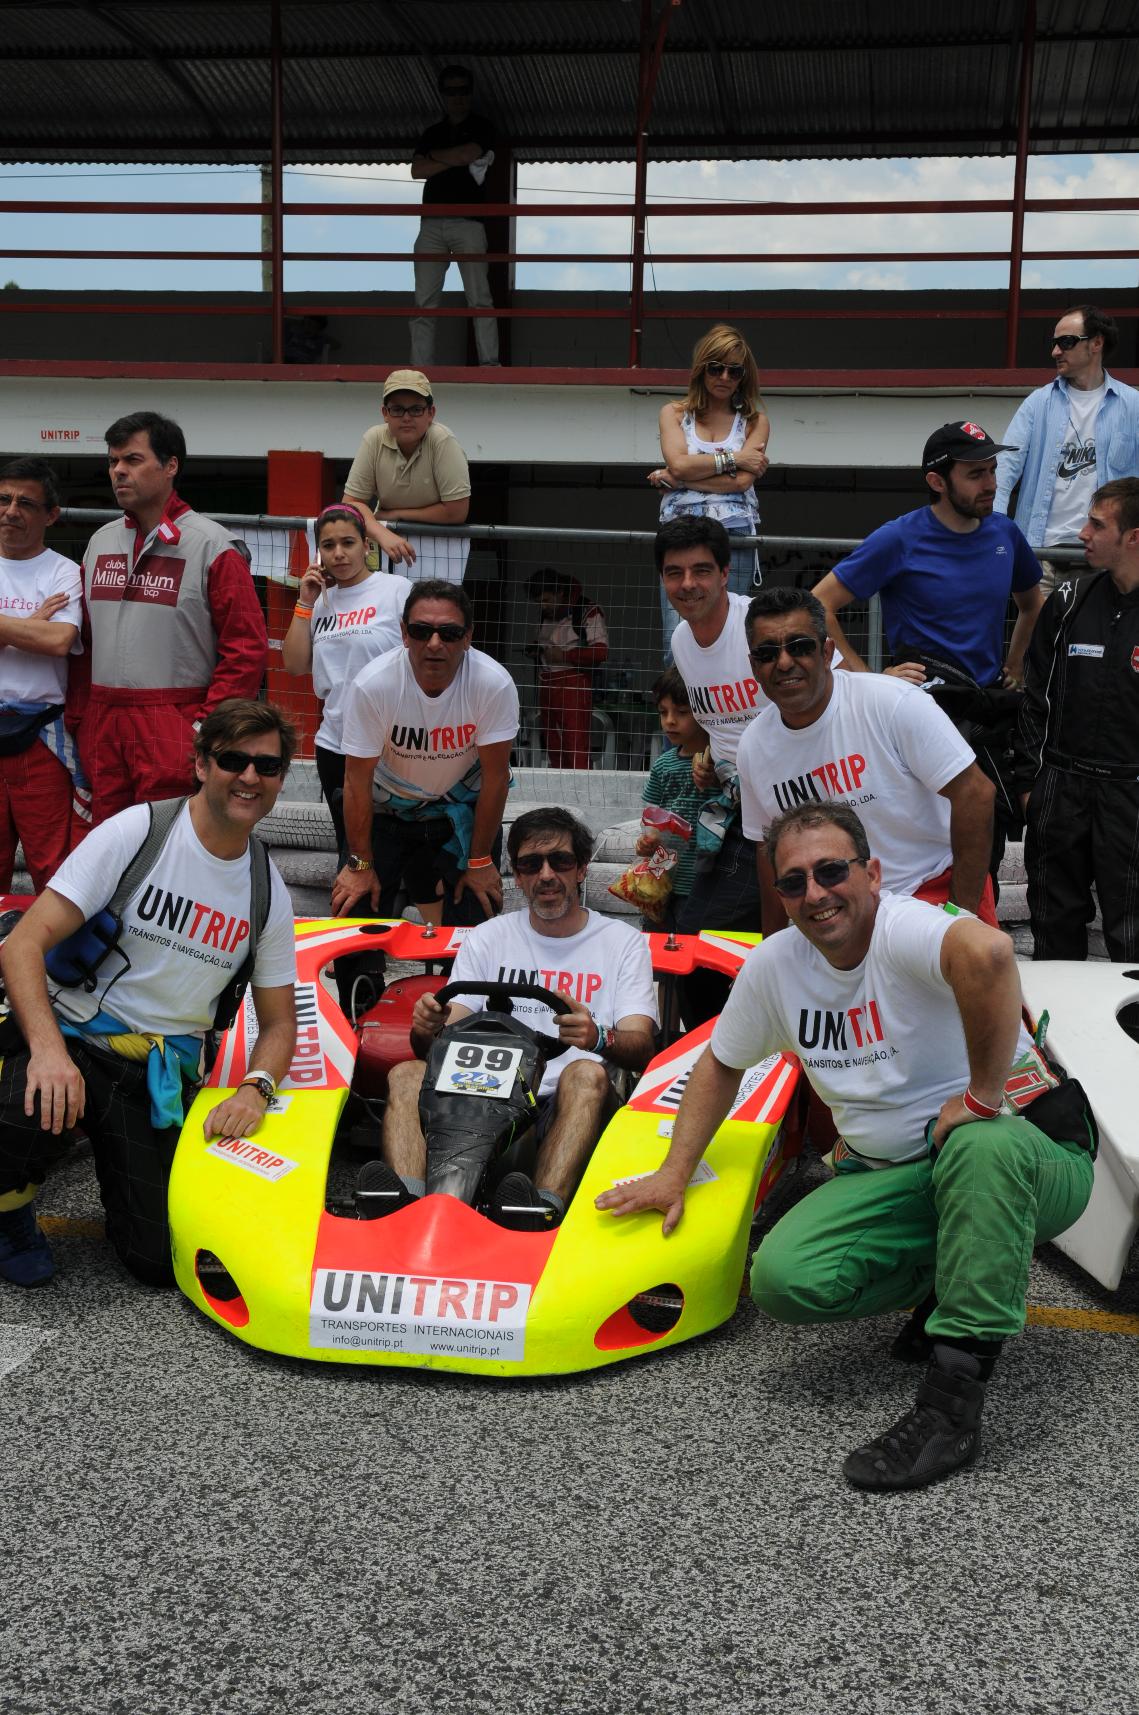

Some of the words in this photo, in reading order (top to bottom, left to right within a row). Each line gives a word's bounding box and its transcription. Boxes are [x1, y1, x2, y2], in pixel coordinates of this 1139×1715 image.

[41, 430, 80, 440] UNITRIP
[105, 560, 126, 570] clube
[143, 587, 159, 598] bcp
[391, 723, 476, 753] UNITRIP
[773, 753, 866, 813] UNITRIP
[859, 793, 878, 805] LDA.
[136, 884, 251, 953] UNITRIP
[128, 925, 171, 947] TRÂNSITOS
[455, 1046, 513, 1071] 99
[845, 1059, 851, 1068] E
[216, 1135, 284, 1168] UNITRIP
[323, 1272, 519, 1322] UNITRIP
[321, 1319, 407, 1333] TRANSPORTES
[414, 1325, 514, 1341] INTERNACIONAIS
[332, 1335, 403, 1348] info@unitrip.pt
[430, 1341, 500, 1356] www.unitrip.pt
